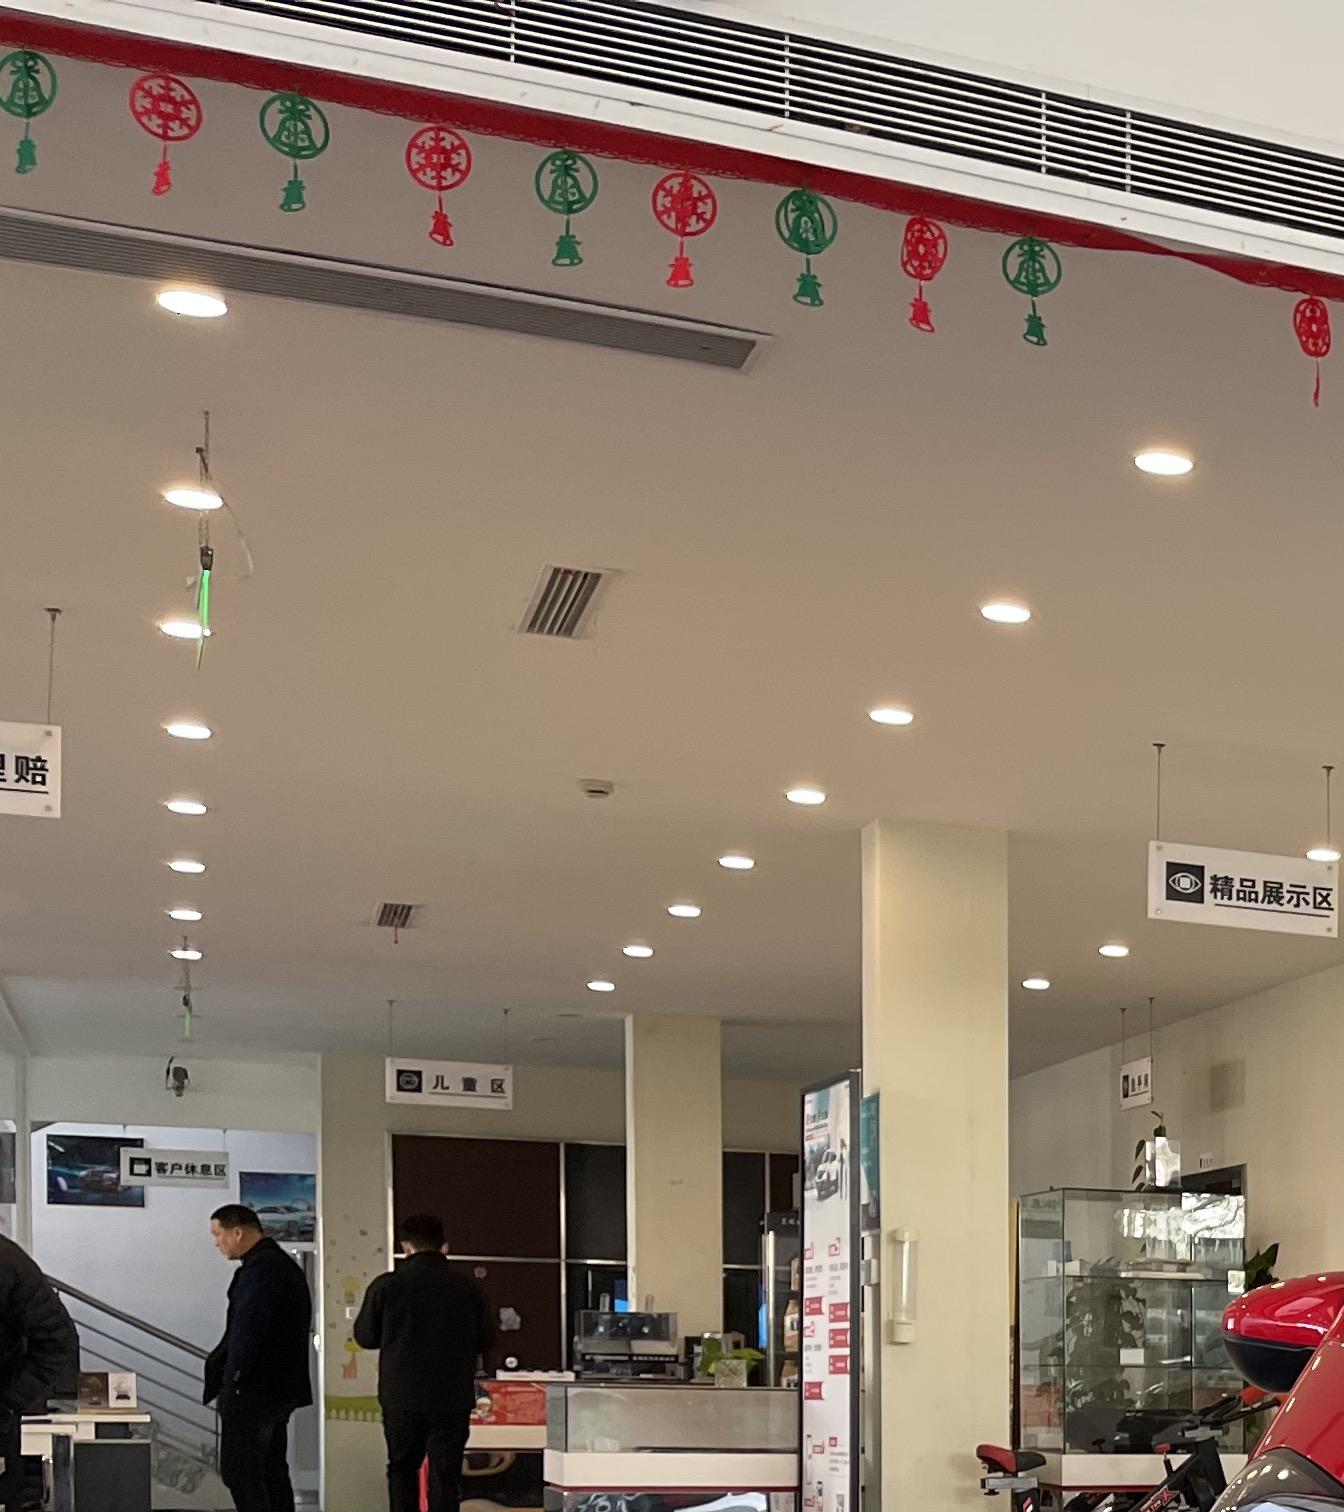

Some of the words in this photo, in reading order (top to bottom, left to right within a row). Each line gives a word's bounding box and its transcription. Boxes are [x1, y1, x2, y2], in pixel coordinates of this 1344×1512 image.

[1210, 874, 1335, 911] 精品展示区
[432, 1075, 505, 1094] 儿童区
[154, 1162, 226, 1177] 客户休息区
